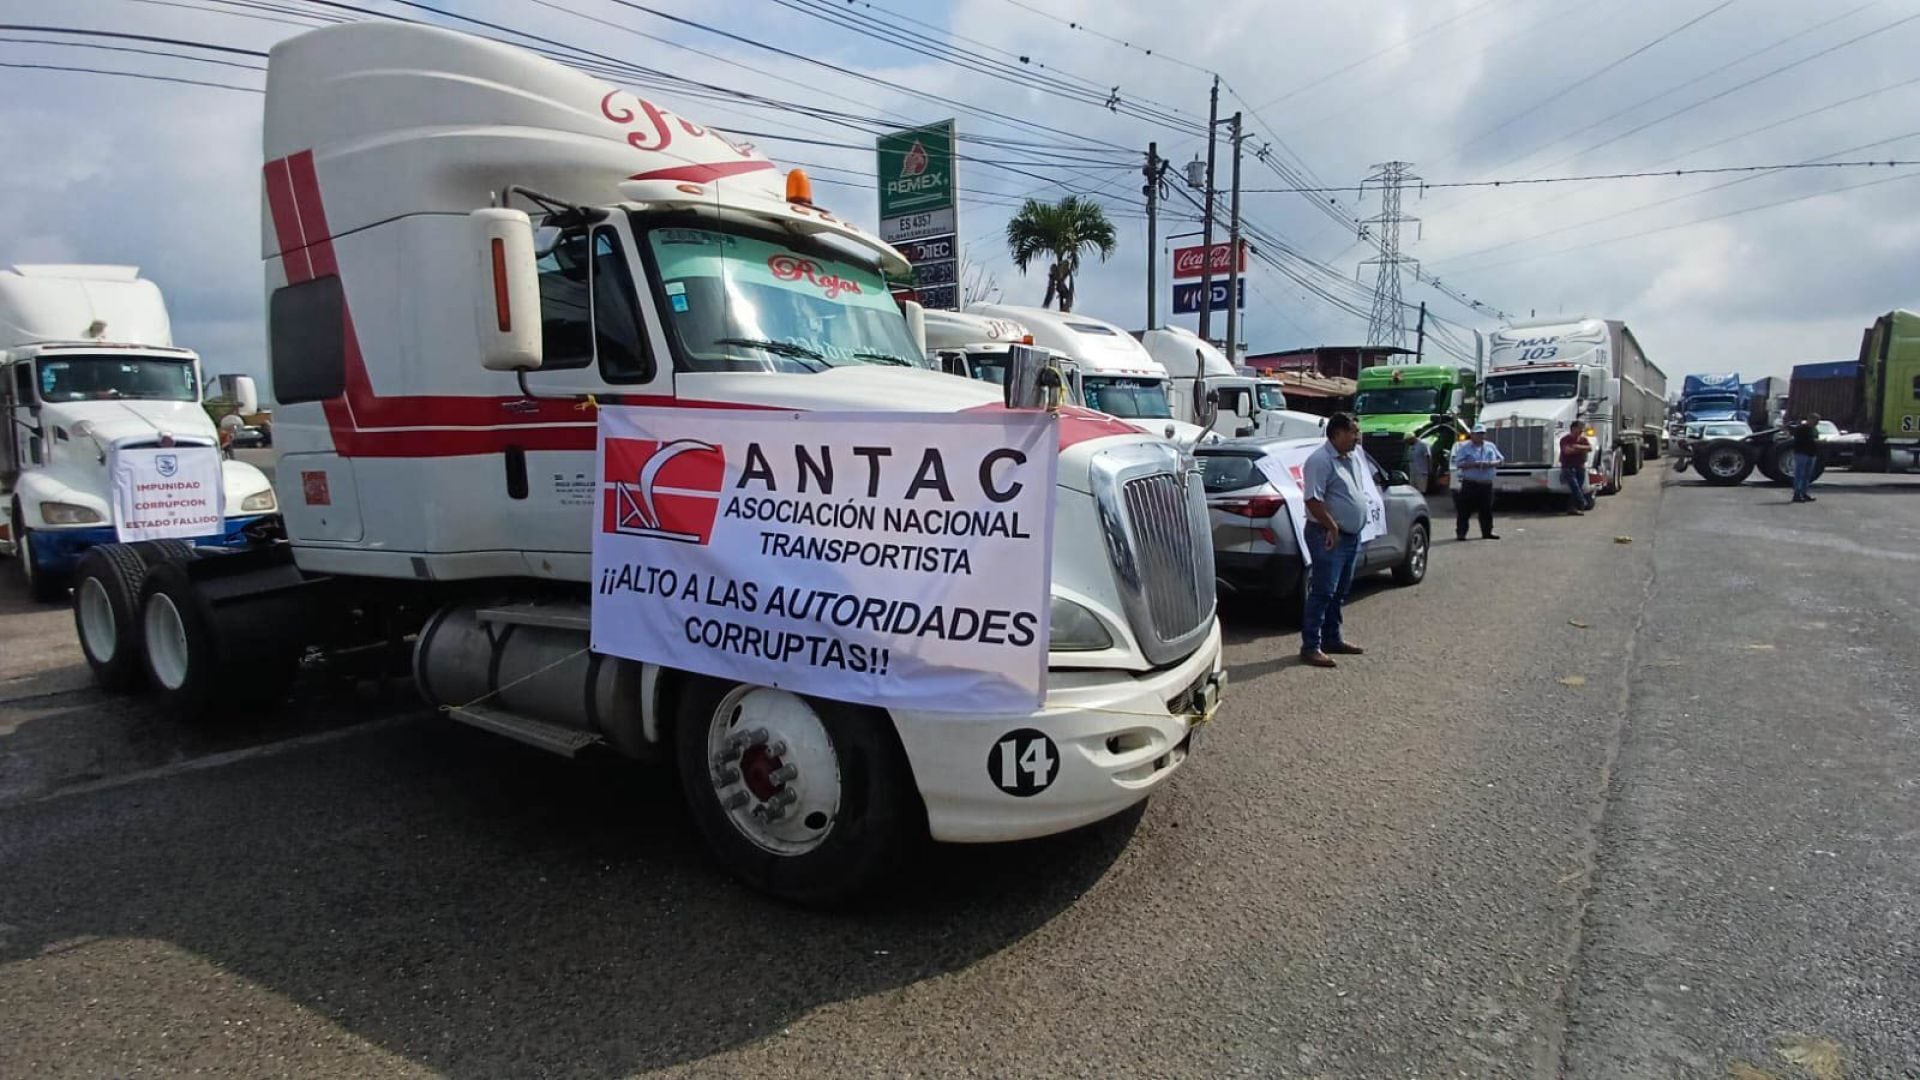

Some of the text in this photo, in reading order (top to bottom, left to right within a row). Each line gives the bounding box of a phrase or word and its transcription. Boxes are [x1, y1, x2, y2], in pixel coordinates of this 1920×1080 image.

[888, 172, 942, 196] PEMEX
[899, 218, 912, 231] ES
[1517, 346, 1558, 361] 103
[137, 481, 201, 492] IMPUNIDAD
[736, 442, 1028, 503] ANTAC
[125, 515, 219, 529] ESTADO FALLIDO
[724, 497, 1031, 539] ASOCIACIÓN NACIONAL
[760, 531, 972, 575] TRANSPORTISTA
[681, 573, 699, 602] A
[706, 575, 759, 613] LAS
[764, 585, 1039, 648] AUTORIDADES
[684, 616, 890, 677] CORRUPTAS!!
[1000, 737, 1055, 788] 14
